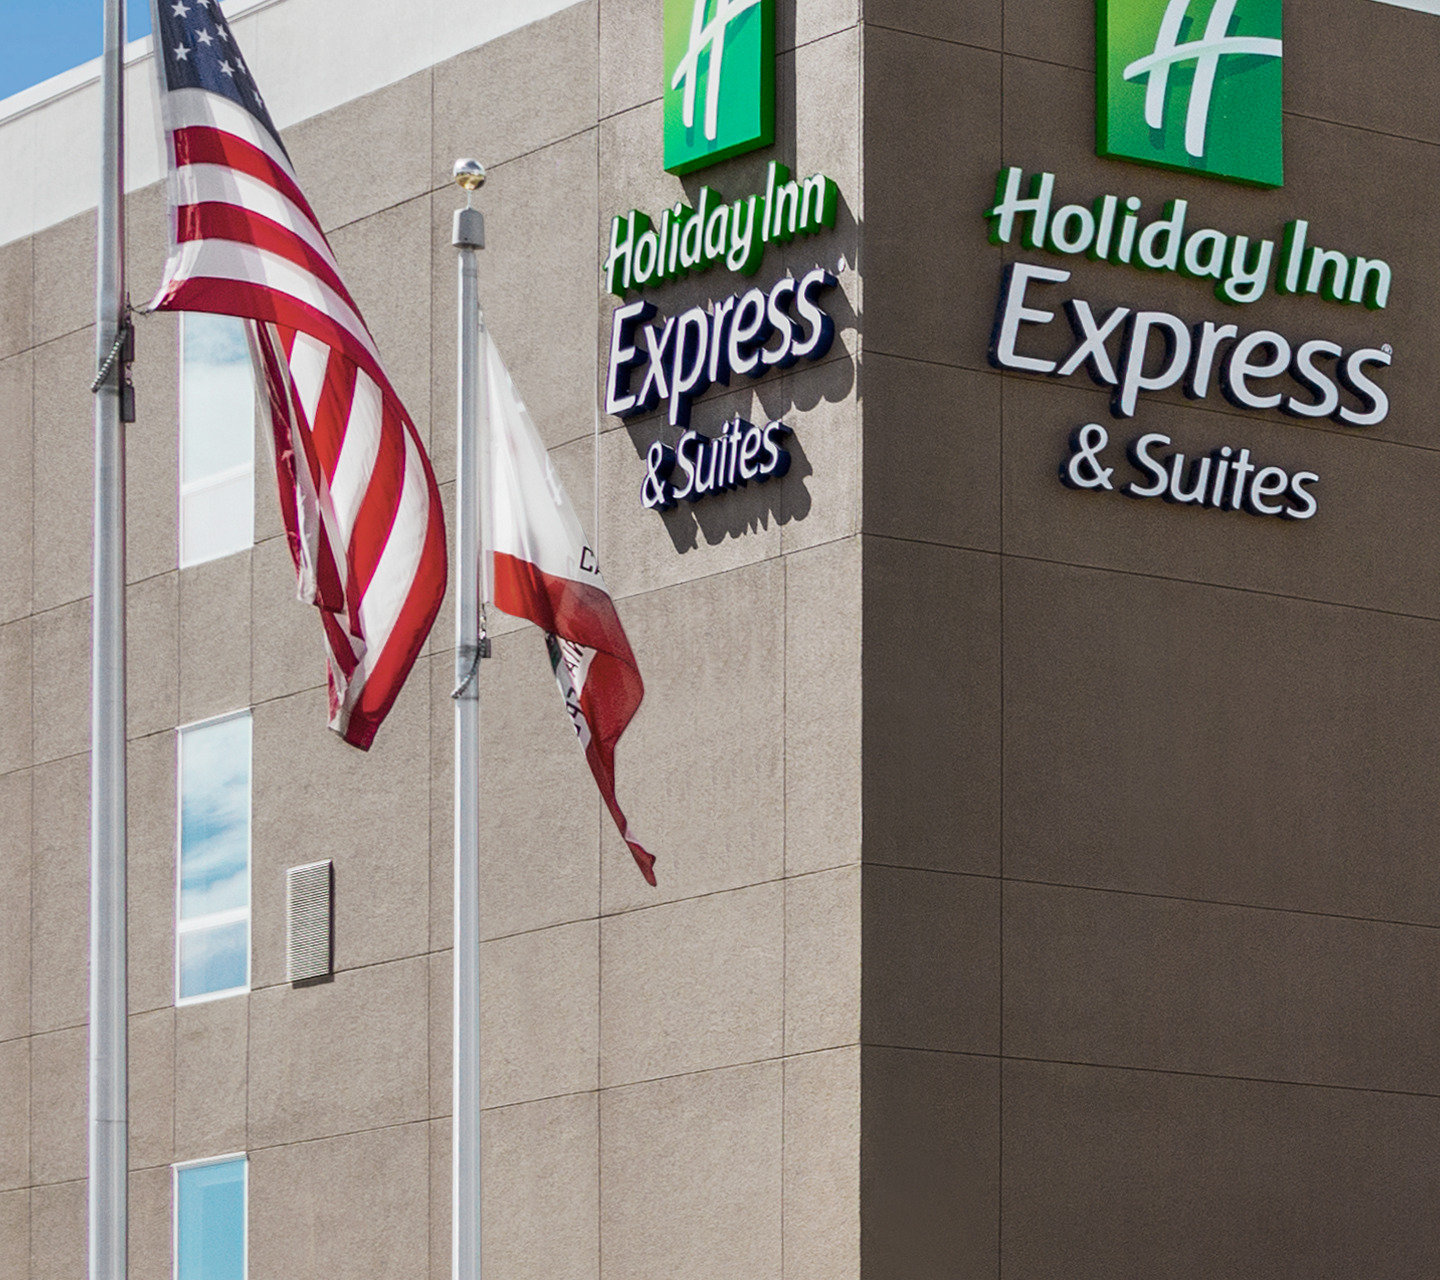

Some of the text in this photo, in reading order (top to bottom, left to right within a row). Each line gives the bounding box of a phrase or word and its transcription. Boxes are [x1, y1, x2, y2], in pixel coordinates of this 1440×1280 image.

[603, 160, 828, 295] Holiday Inn
[991, 165, 1392, 309] Holiday Inn
[604, 266, 827, 426] Express
[640, 416, 783, 509] & Suites
[1066, 422, 1321, 520] & Suites
